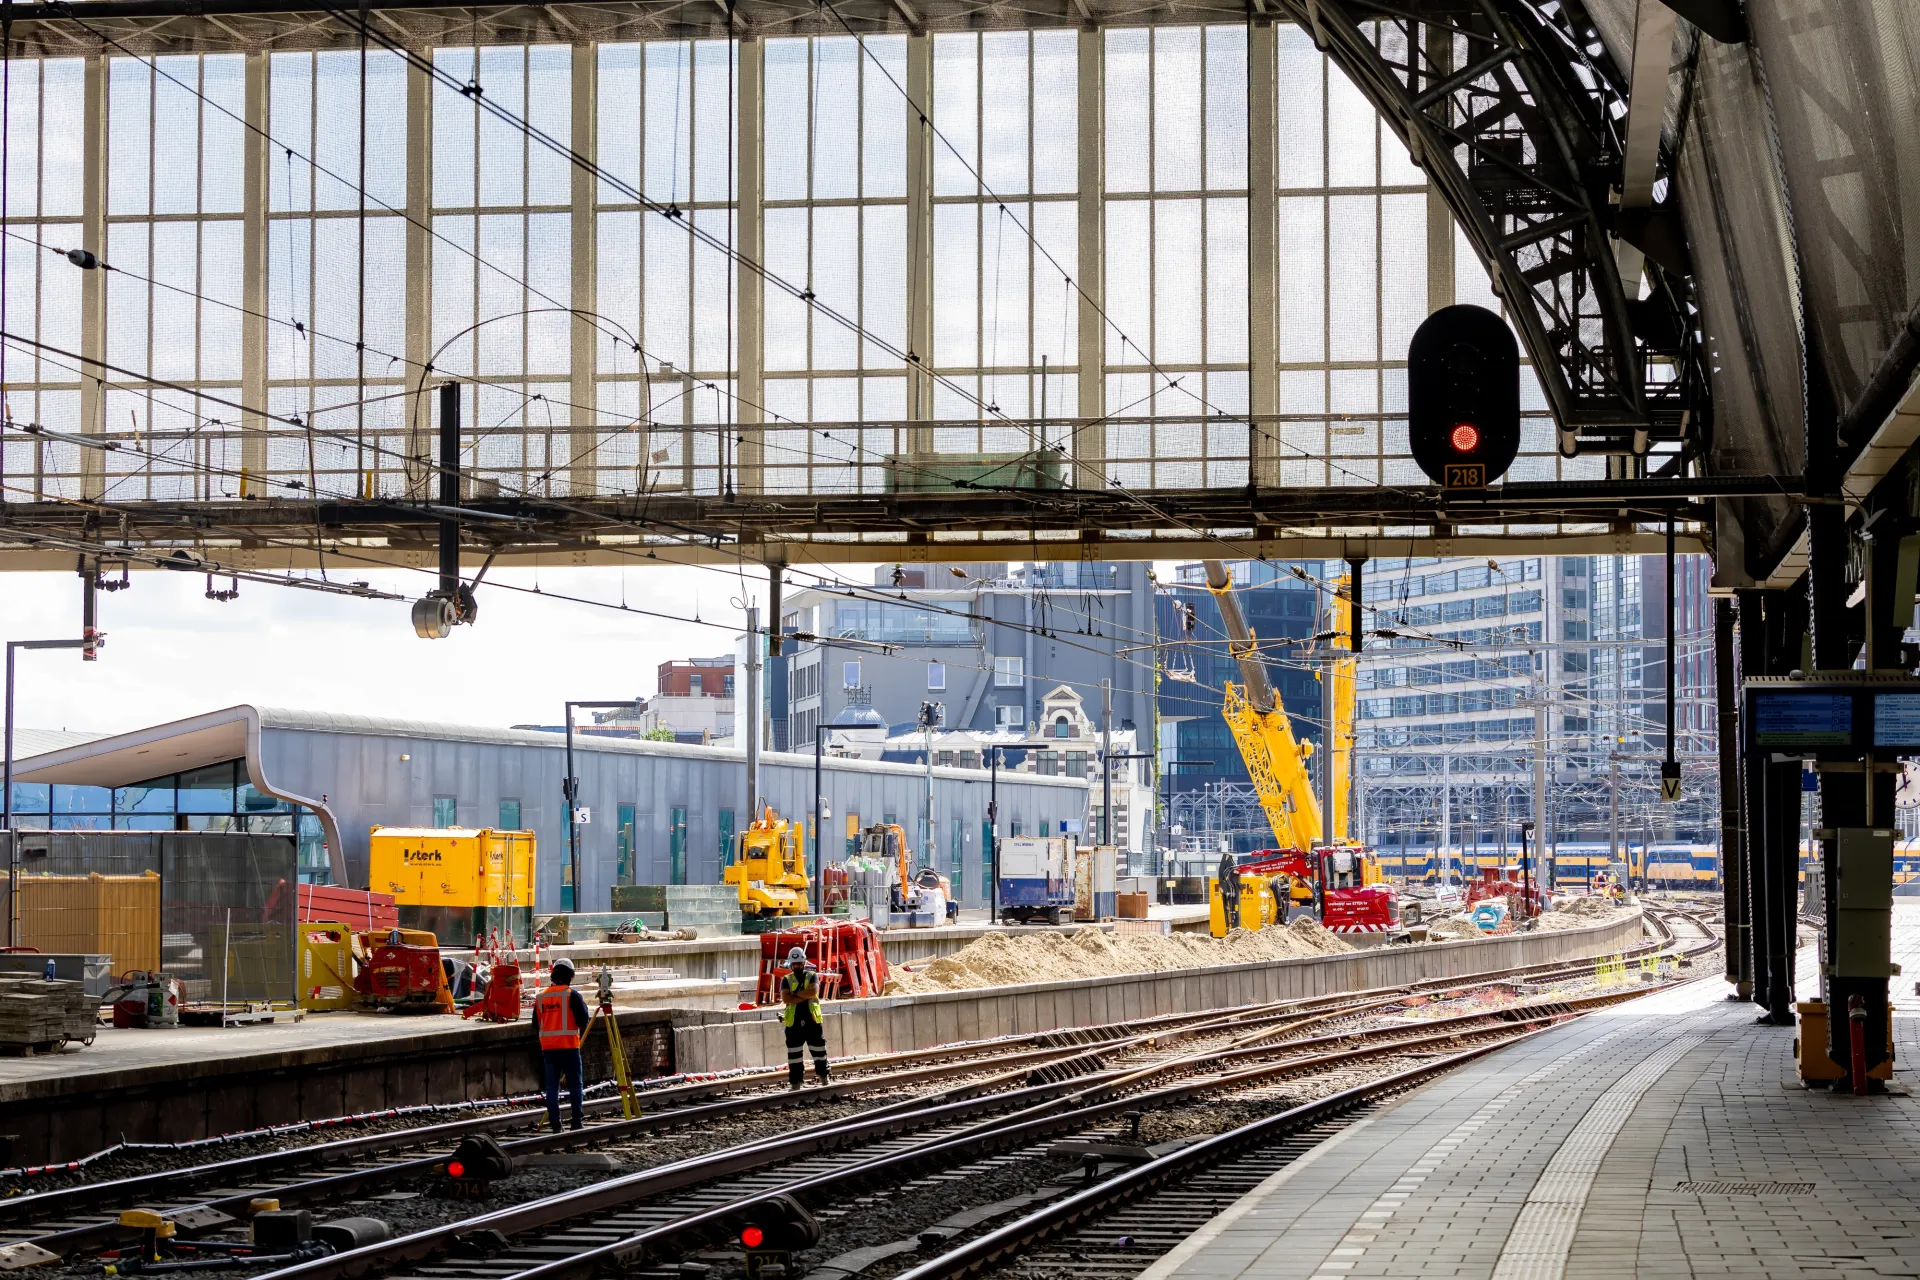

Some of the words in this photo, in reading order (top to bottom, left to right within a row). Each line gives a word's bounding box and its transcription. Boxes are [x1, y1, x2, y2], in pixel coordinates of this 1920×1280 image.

[1452, 469, 1478, 485] 218
[1664, 780, 1679, 798] V
[581, 813, 587, 822] S
[1527, 830, 1534, 838] V
[455, 1182, 479, 1197] 214
